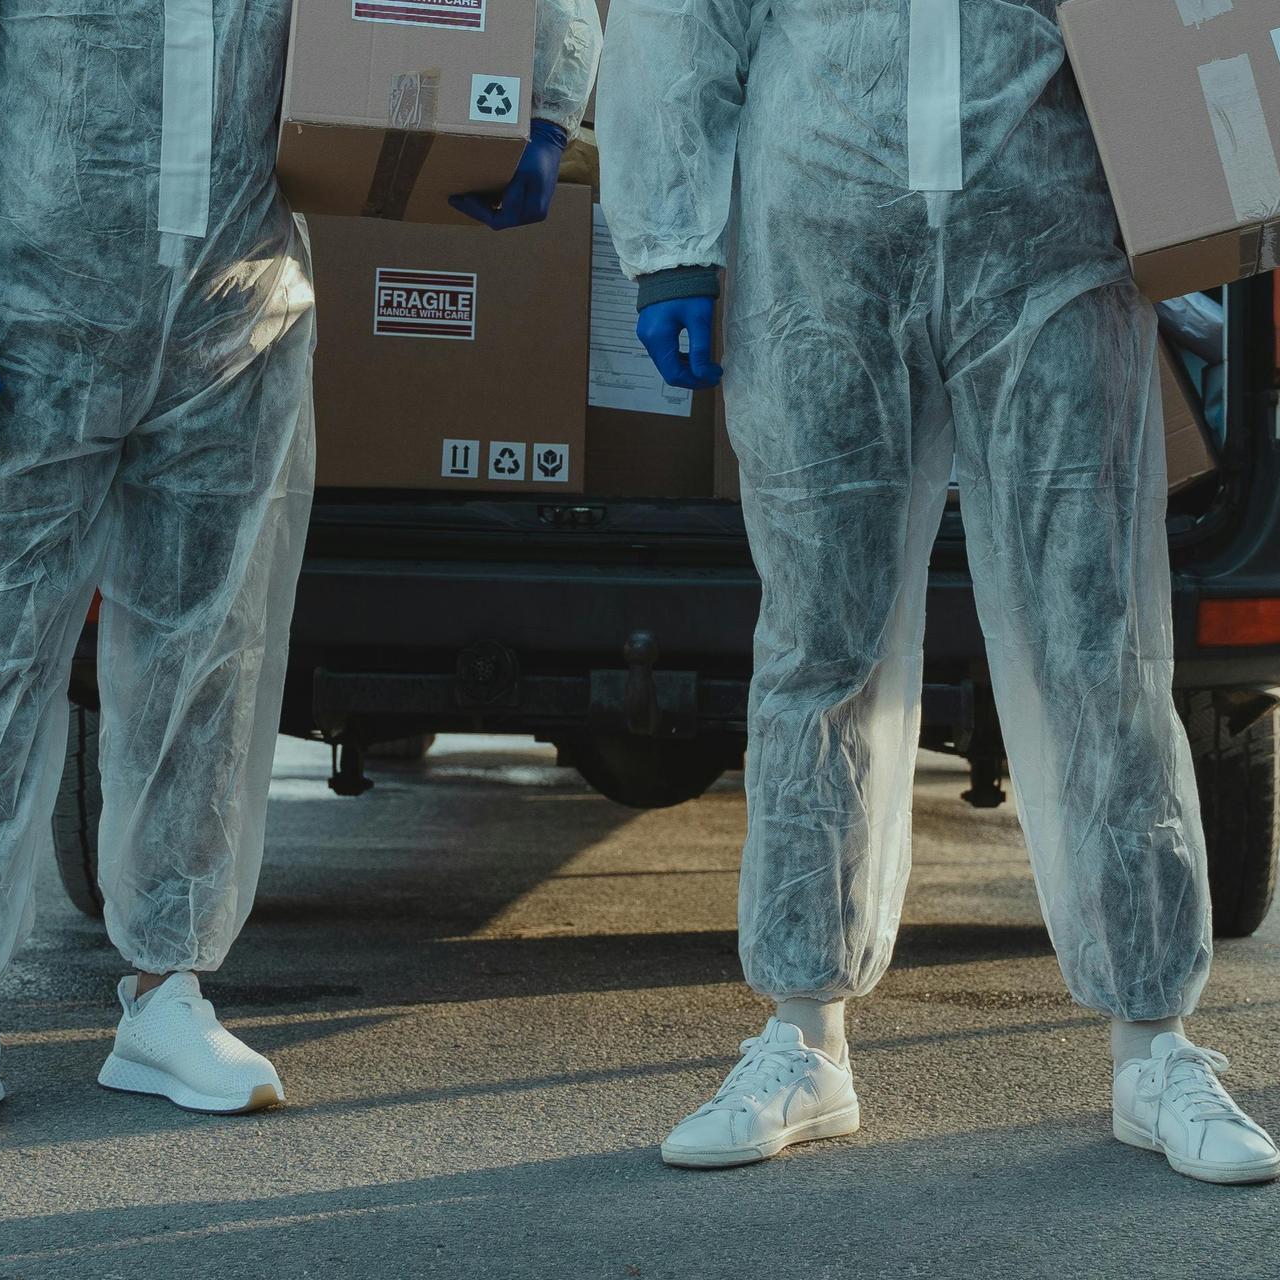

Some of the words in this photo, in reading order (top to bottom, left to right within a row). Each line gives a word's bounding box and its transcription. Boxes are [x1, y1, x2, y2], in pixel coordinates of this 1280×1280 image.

[380, 290, 470, 311] FRAGILE
[379, 307, 417, 317] HANDLE
[419, 310, 442, 318] WITH
[444, 311, 470, 320] CARE
